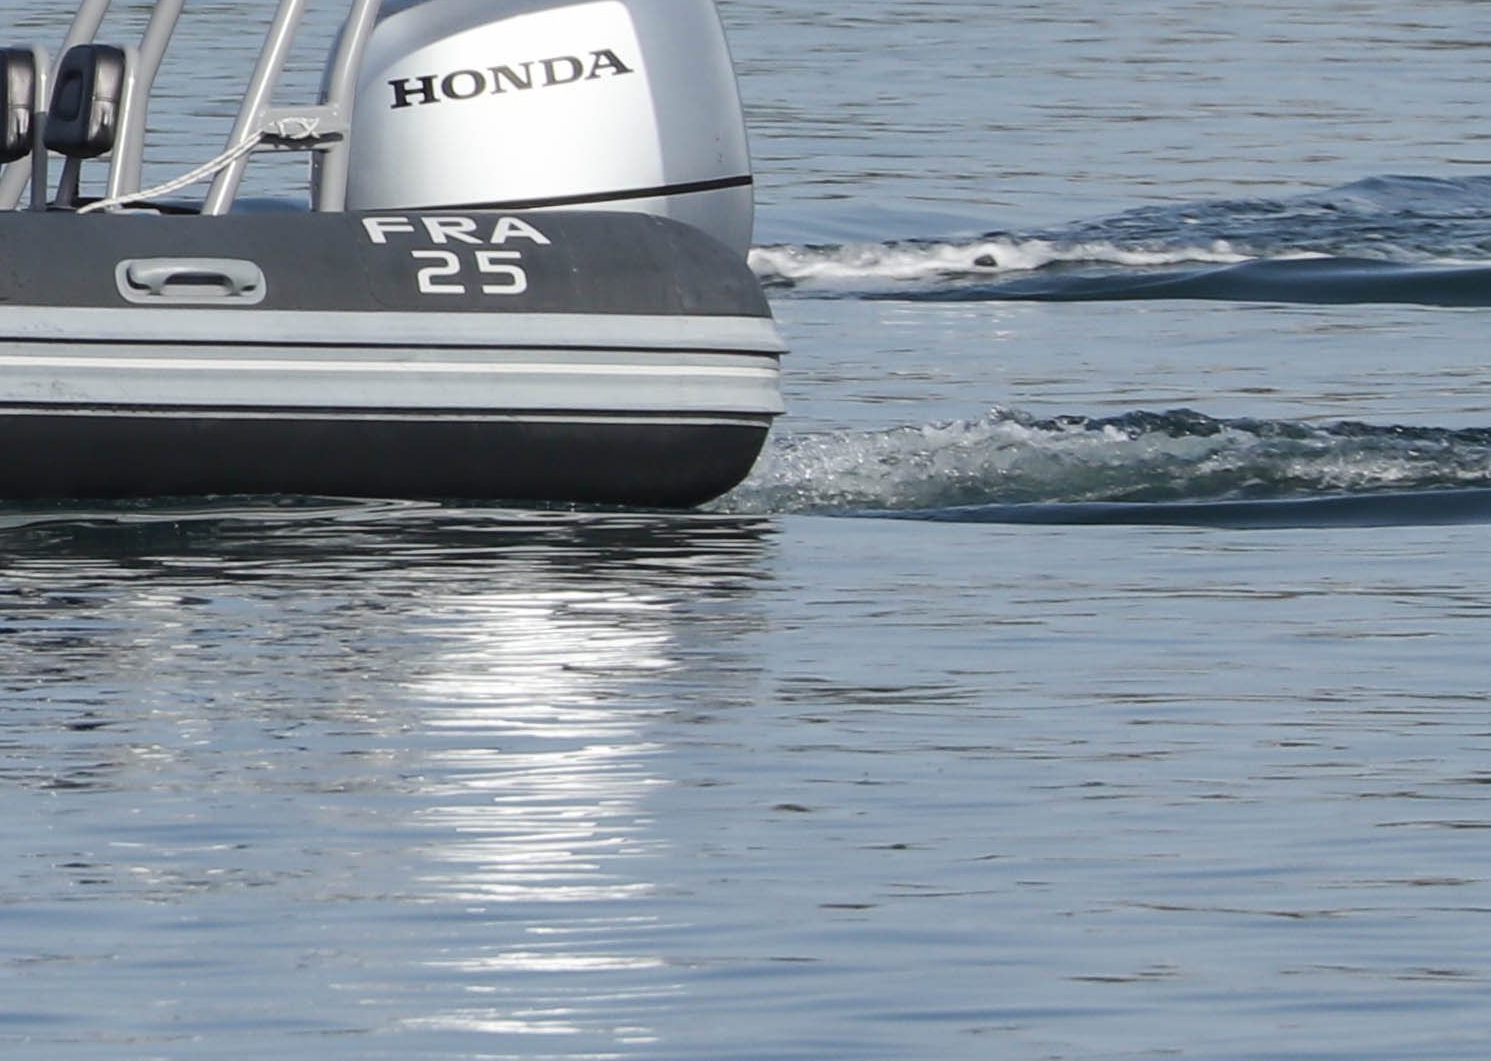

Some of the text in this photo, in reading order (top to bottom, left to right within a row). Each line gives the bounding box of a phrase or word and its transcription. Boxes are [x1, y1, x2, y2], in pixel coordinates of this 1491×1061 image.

[388, 48, 634, 109] HONDA
[362, 217, 552, 244] FRA
[411, 250, 527, 294] 25
